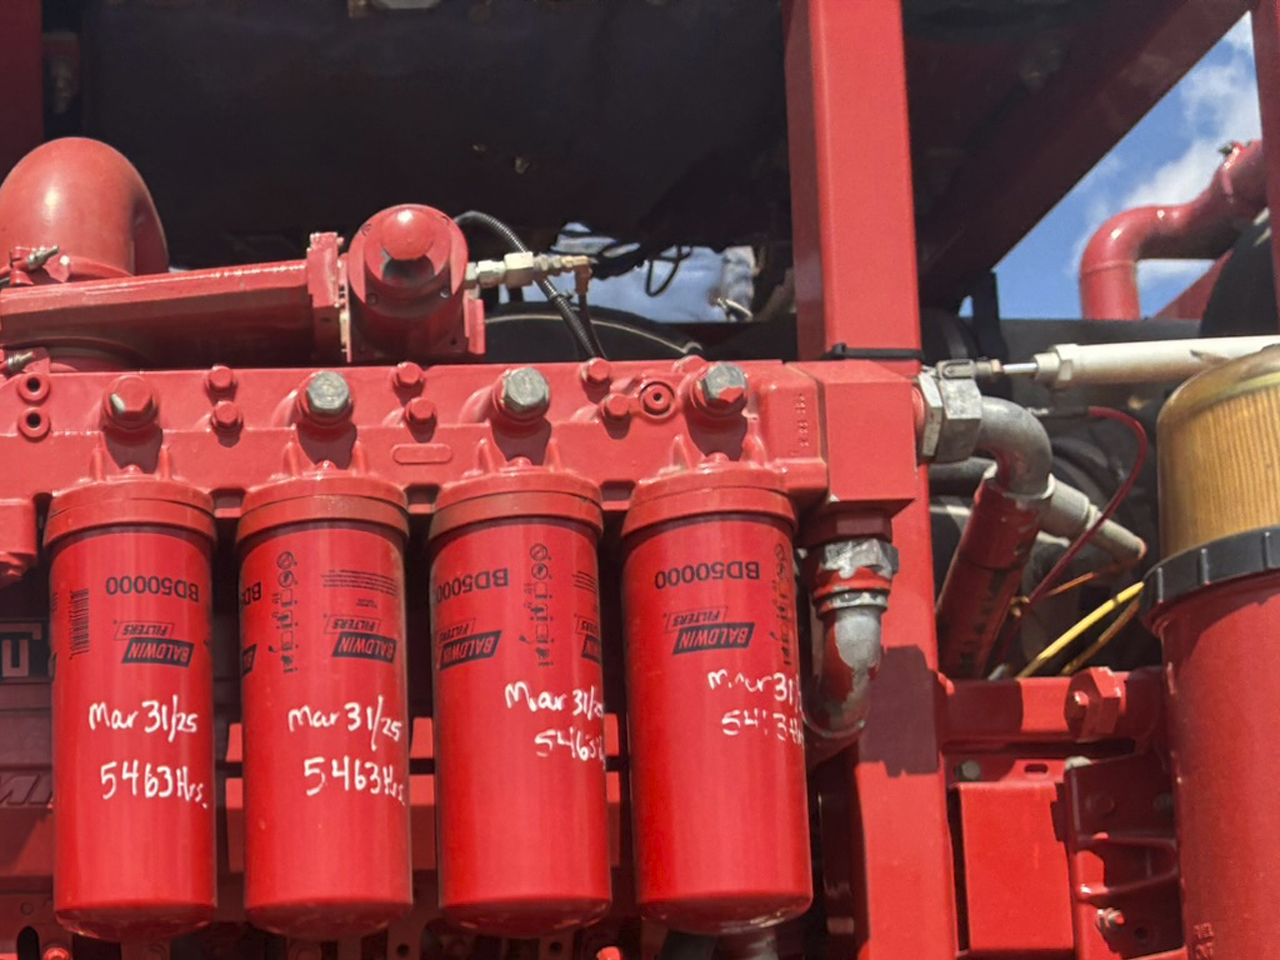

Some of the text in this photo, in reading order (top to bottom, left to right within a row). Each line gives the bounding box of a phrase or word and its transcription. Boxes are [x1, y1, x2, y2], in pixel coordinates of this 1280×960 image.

[654, 561, 760, 590] BD50000
[106, 575, 200, 603] BD50000
[333, 619, 375, 631] FILTERS
[673, 610, 720, 626] FILTERS
[122, 624, 169, 636] FILTERS
[679, 627, 748, 650] BALDWIN
[128, 641, 191, 663] BALDWIN
[338, 636, 394, 658] BALDWIN
[505, 681, 567, 712] Mar
[89, 694, 198, 743] Mar 31/25
[288, 695, 402, 751] Mar 31/25
